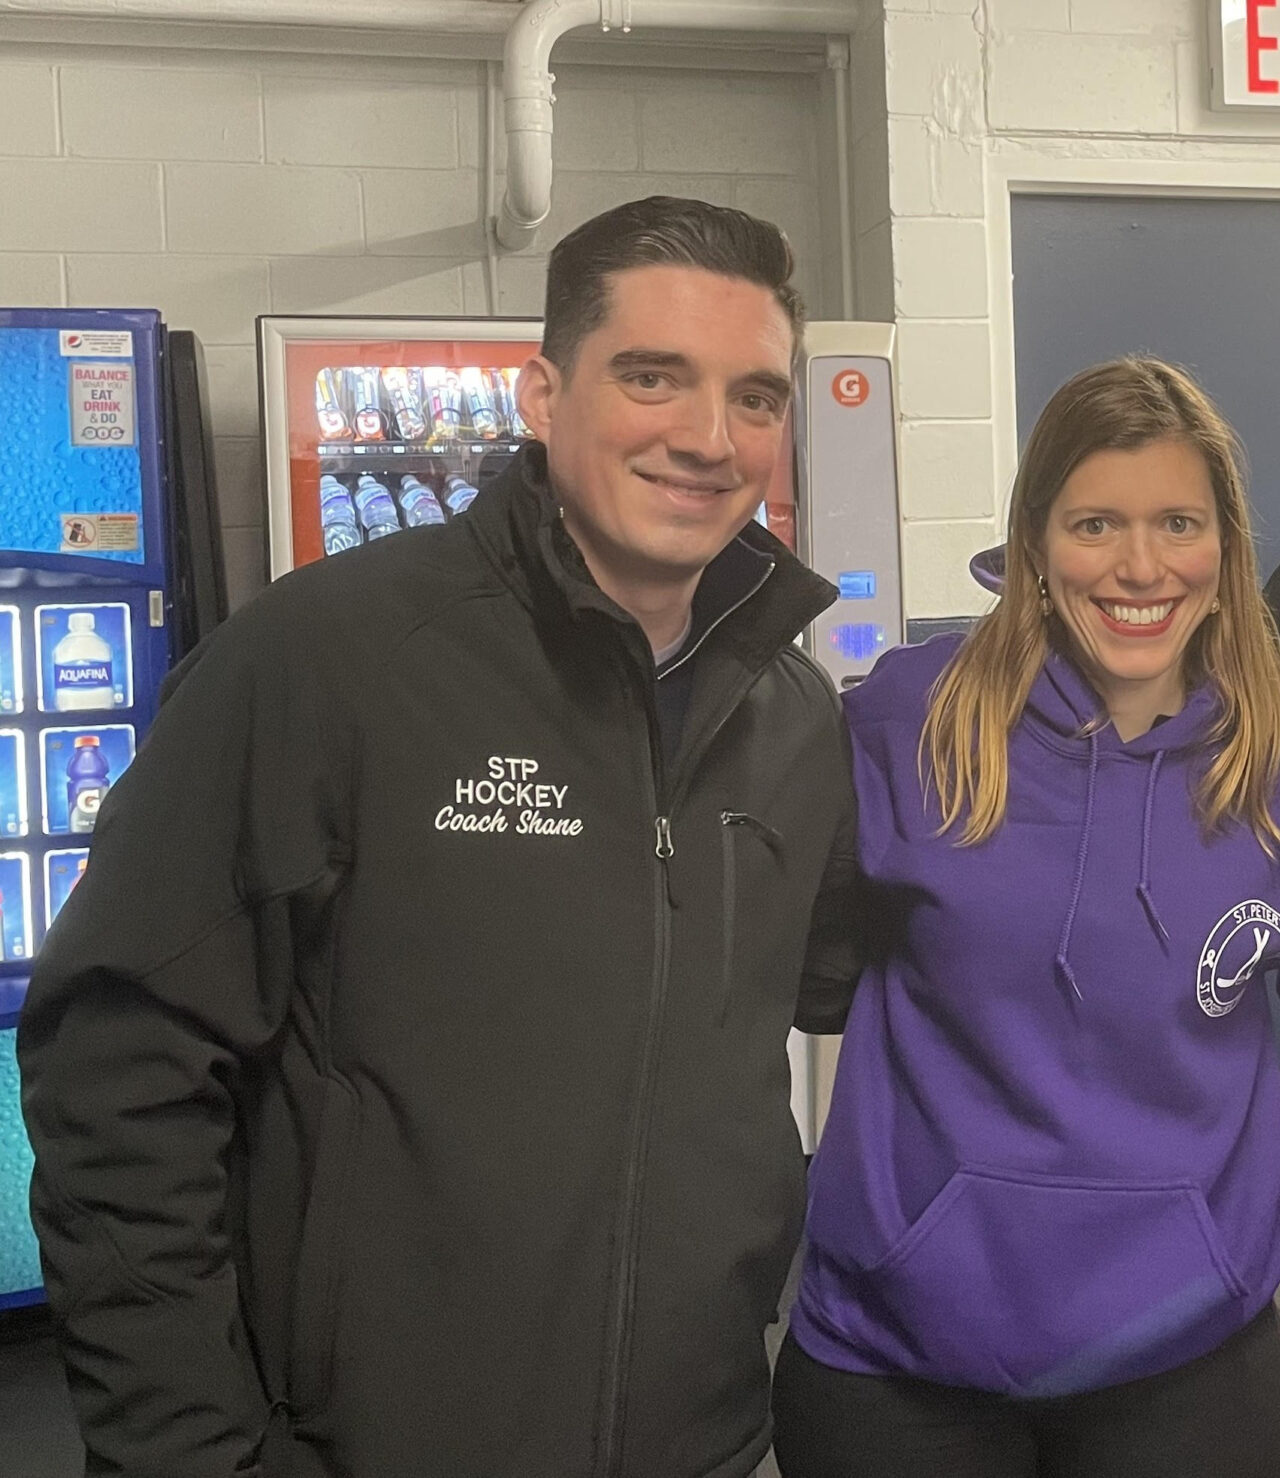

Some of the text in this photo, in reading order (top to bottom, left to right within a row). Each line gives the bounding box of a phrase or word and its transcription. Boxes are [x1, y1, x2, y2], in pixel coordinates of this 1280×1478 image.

[75, 369, 129, 380] BALANCE
[82, 381, 105, 389] WHAT
[840, 374, 860, 397] G
[91, 389, 113, 400] EAT
[84, 401, 120, 412] DRINK
[90, 412, 117, 424] & DO
[59, 669, 109, 682] AQUAFINA
[487, 756, 539, 781] STP
[456, 778, 568, 809] HOCKEY
[434, 805, 584, 836] Coach Shane
